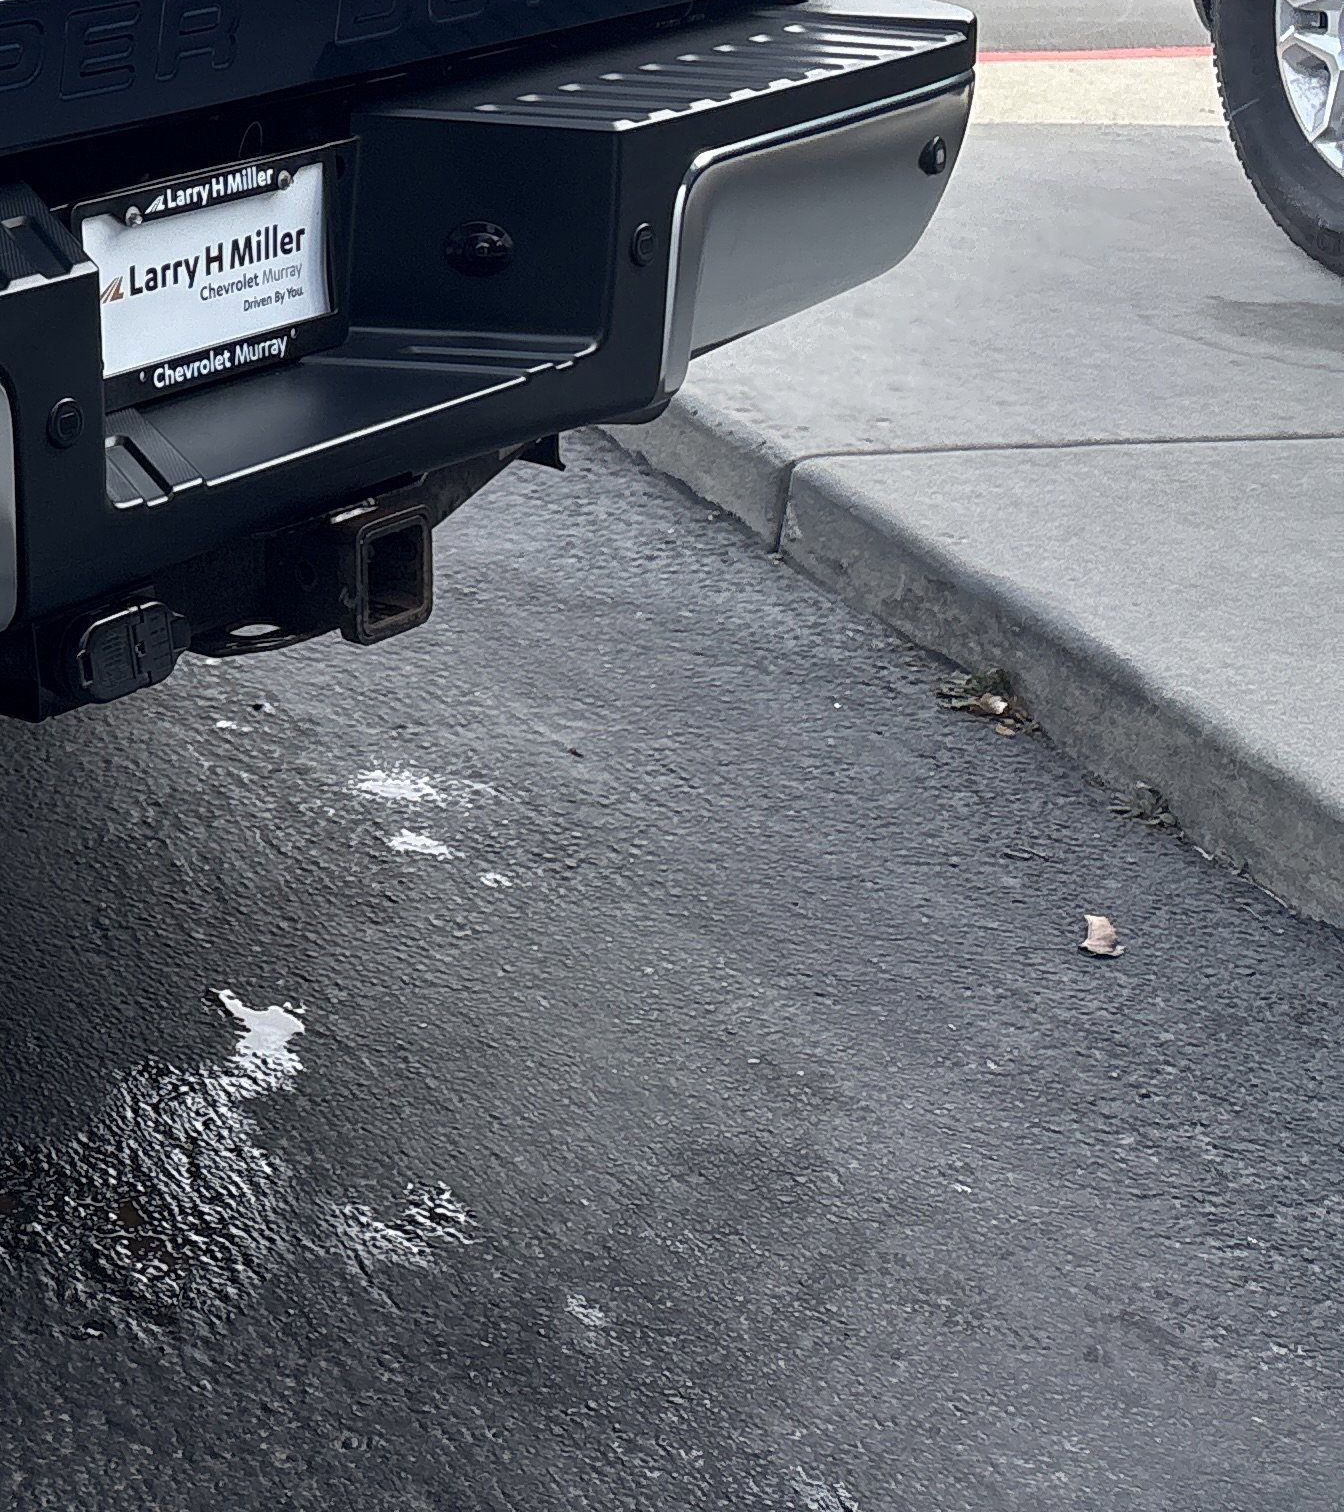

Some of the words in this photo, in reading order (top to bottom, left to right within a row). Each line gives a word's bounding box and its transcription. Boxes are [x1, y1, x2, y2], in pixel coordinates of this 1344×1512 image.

[166, 183, 210, 206] Larry
[212, 175, 224, 198] H
[226, 165, 274, 195] Miller
[129, 255, 200, 297] Larry
[205, 242, 224, 276] H
[229, 224, 306, 271] Miller
[199, 272, 260, 301] Chevrolet
[262, 262, 303, 285] Murray
[243, 295, 273, 313] Driven
[274, 290, 286, 305] By
[152, 350, 232, 389] Chevrolet
[234, 335, 288, 367] Murray
